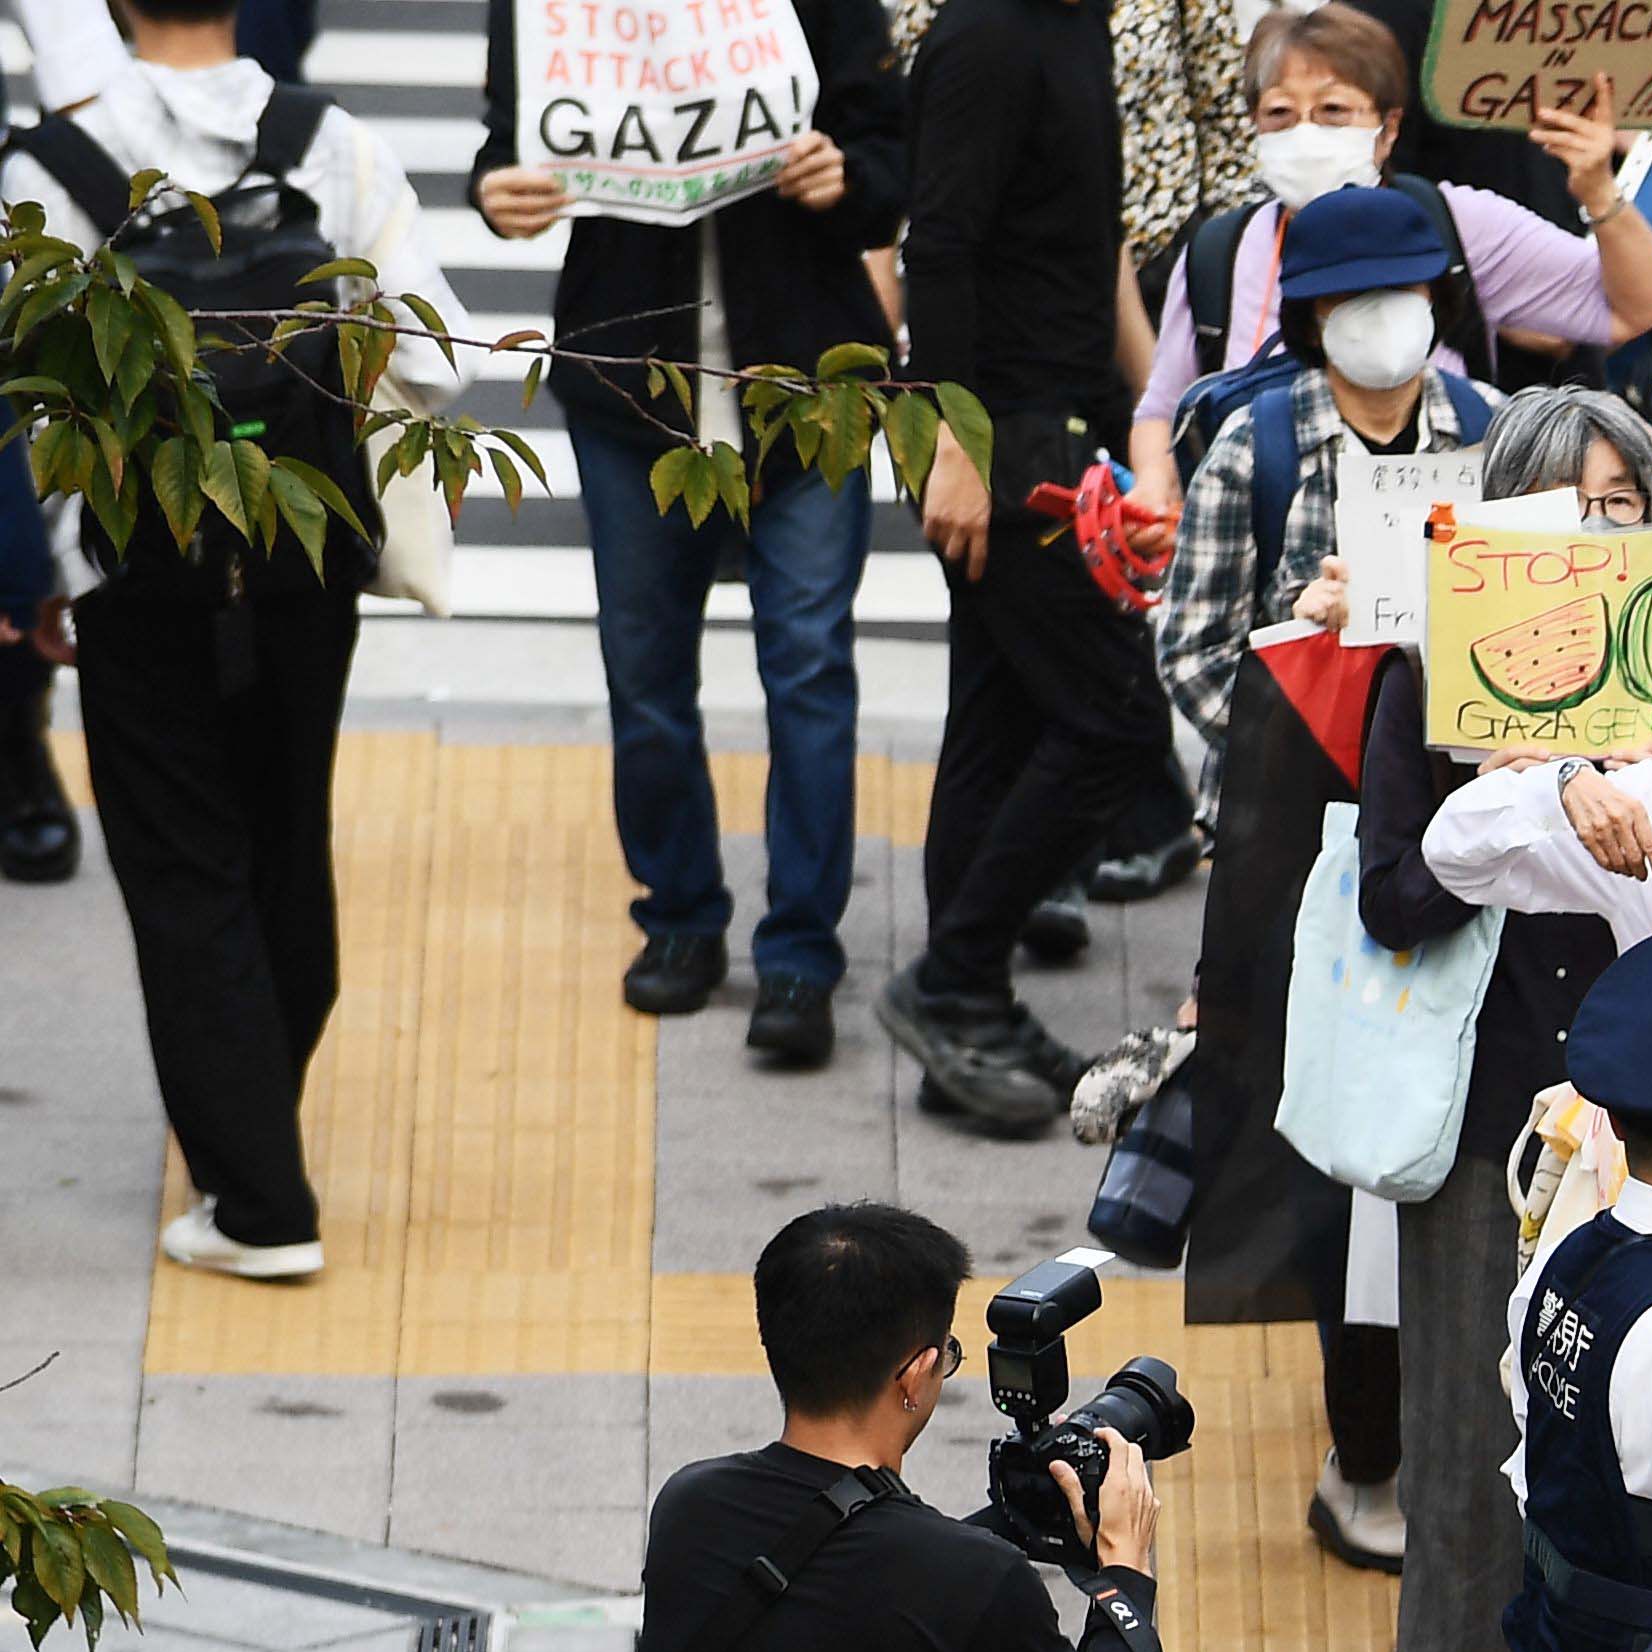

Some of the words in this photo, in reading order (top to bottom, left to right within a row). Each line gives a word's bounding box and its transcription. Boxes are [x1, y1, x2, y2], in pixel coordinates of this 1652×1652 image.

[545, 2, 668, 44] STOP
[687, 0, 770, 36] THE
[545, 48, 716, 93] ATTACK
[728, 30, 782, 75] ON
[1542, 49, 1576, 68] IN
[539, 75, 801, 163] GAZA!
[1448, 540, 1629, 593] STOP!
[1456, 699, 1577, 742] GAZA
